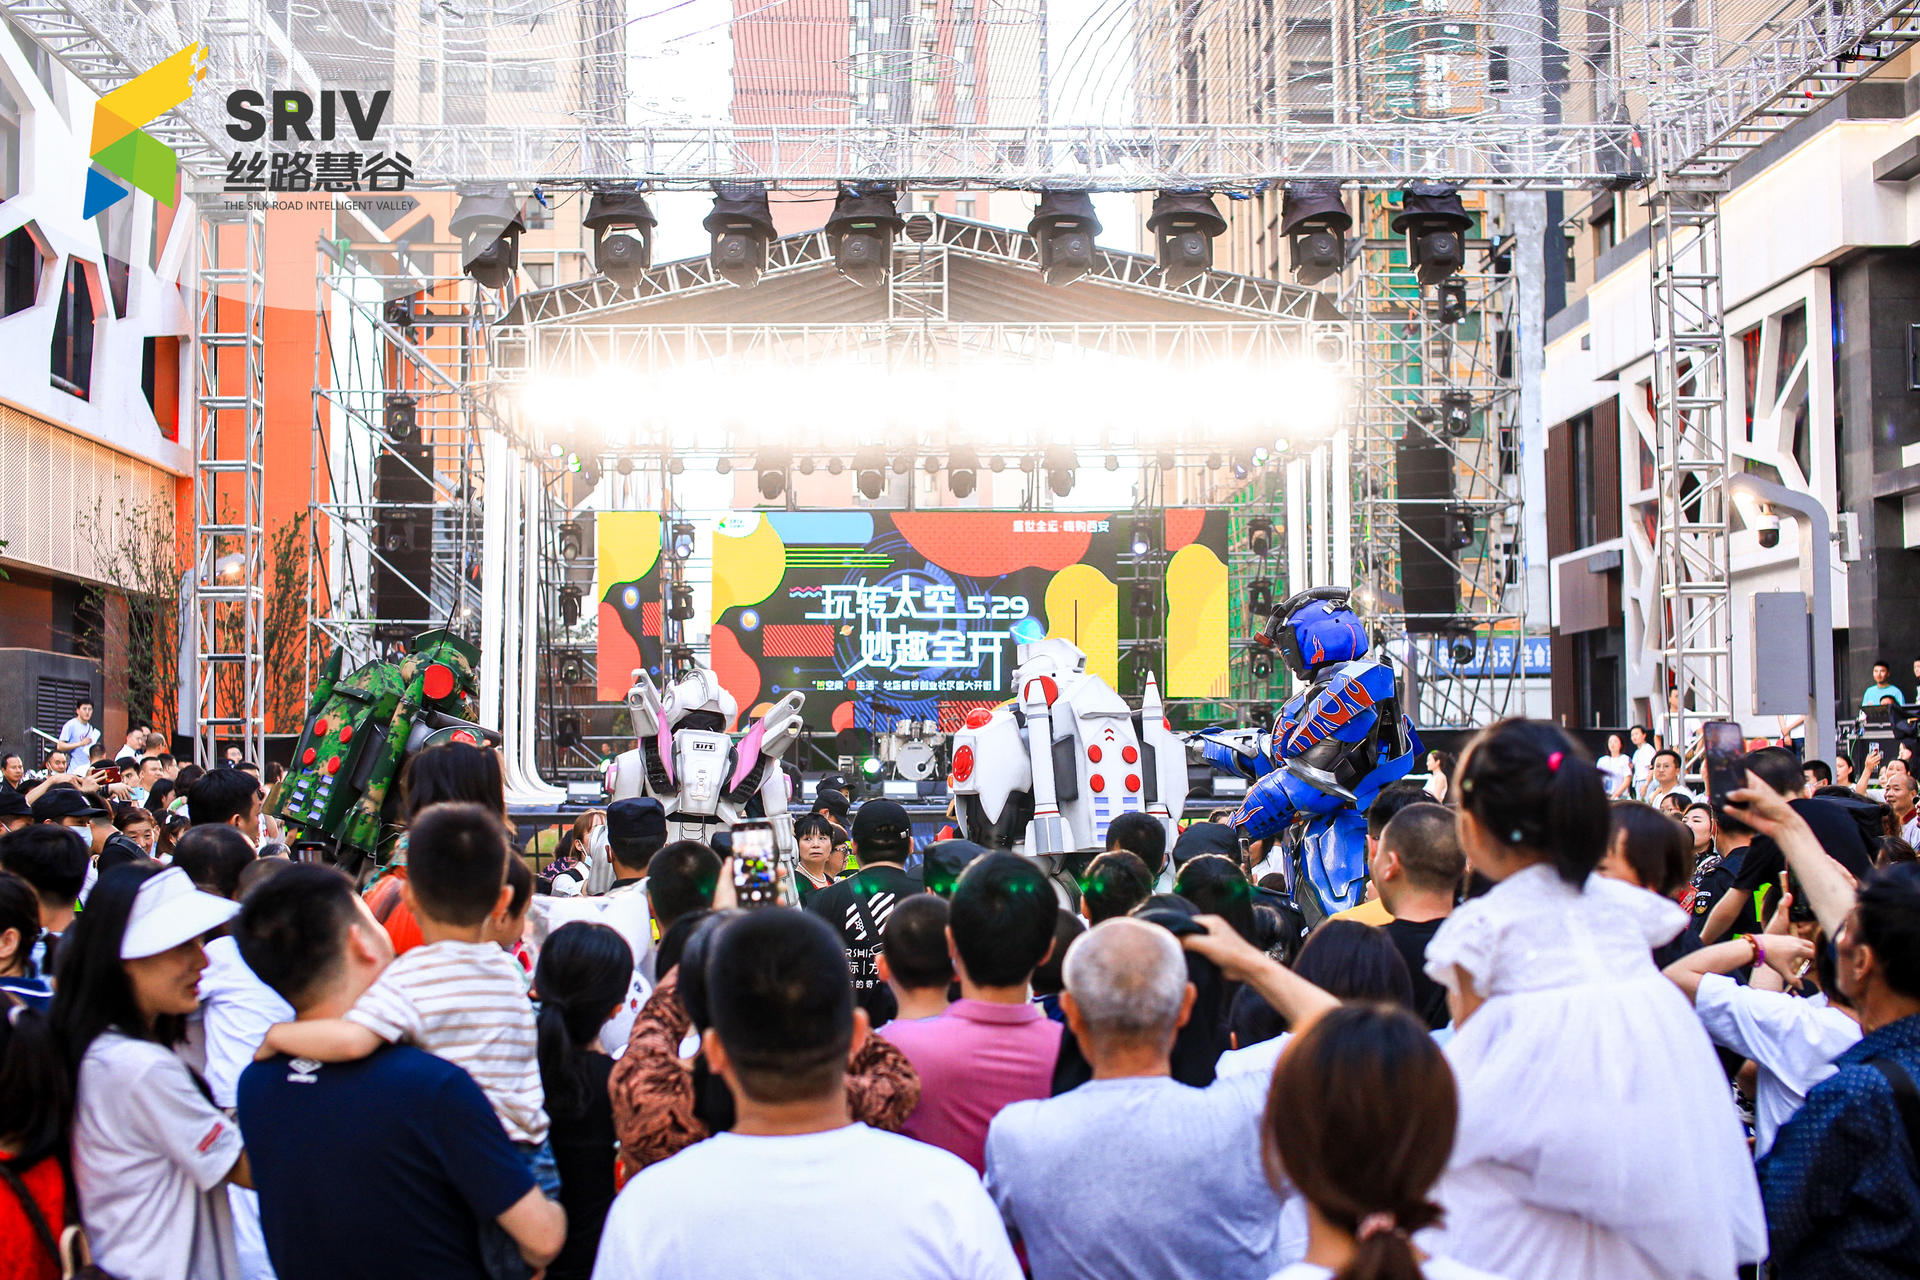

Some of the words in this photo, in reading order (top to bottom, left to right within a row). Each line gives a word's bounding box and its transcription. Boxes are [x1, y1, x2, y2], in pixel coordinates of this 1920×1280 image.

[967, 595, 1030, 620] 5.29
[842, 624, 1011, 691] 妙趣全开
